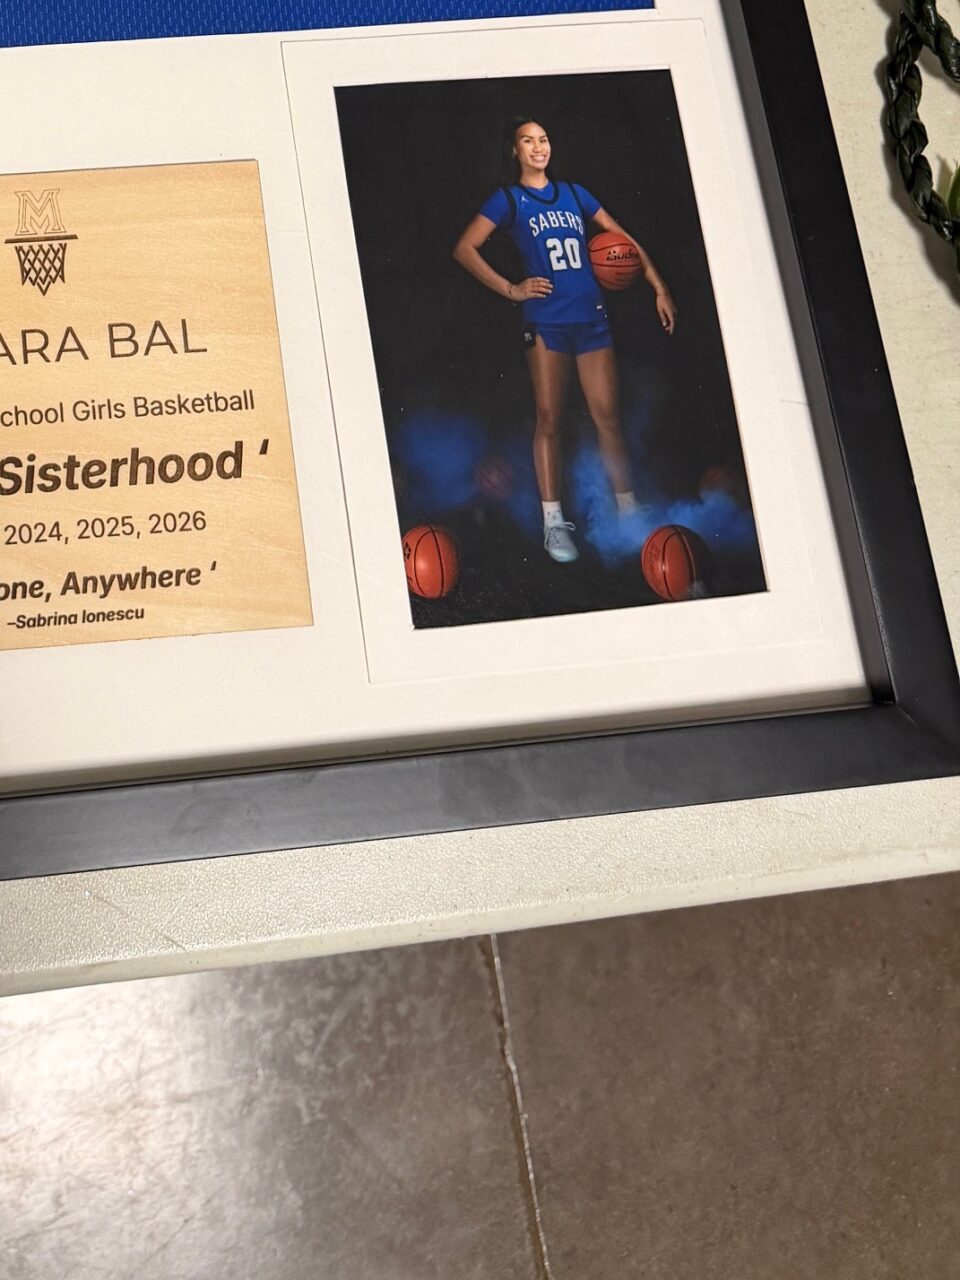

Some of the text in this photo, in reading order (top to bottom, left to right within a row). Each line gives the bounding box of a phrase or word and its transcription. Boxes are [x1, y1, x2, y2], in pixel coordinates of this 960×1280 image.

[13, 187, 68, 236] M
[528, 211, 584, 238] SABERS
[546, 237, 582, 271] 20
[107, 318, 208, 359] BAL
[72, 398, 126, 422] Girls
[132, 388, 255, 418] Basketball
[3, 520, 69, 546] 2024,
[76, 515, 141, 540] 2025,
[148, 510, 207, 535] 2026
[81, 607, 145, 625] Ionescu
